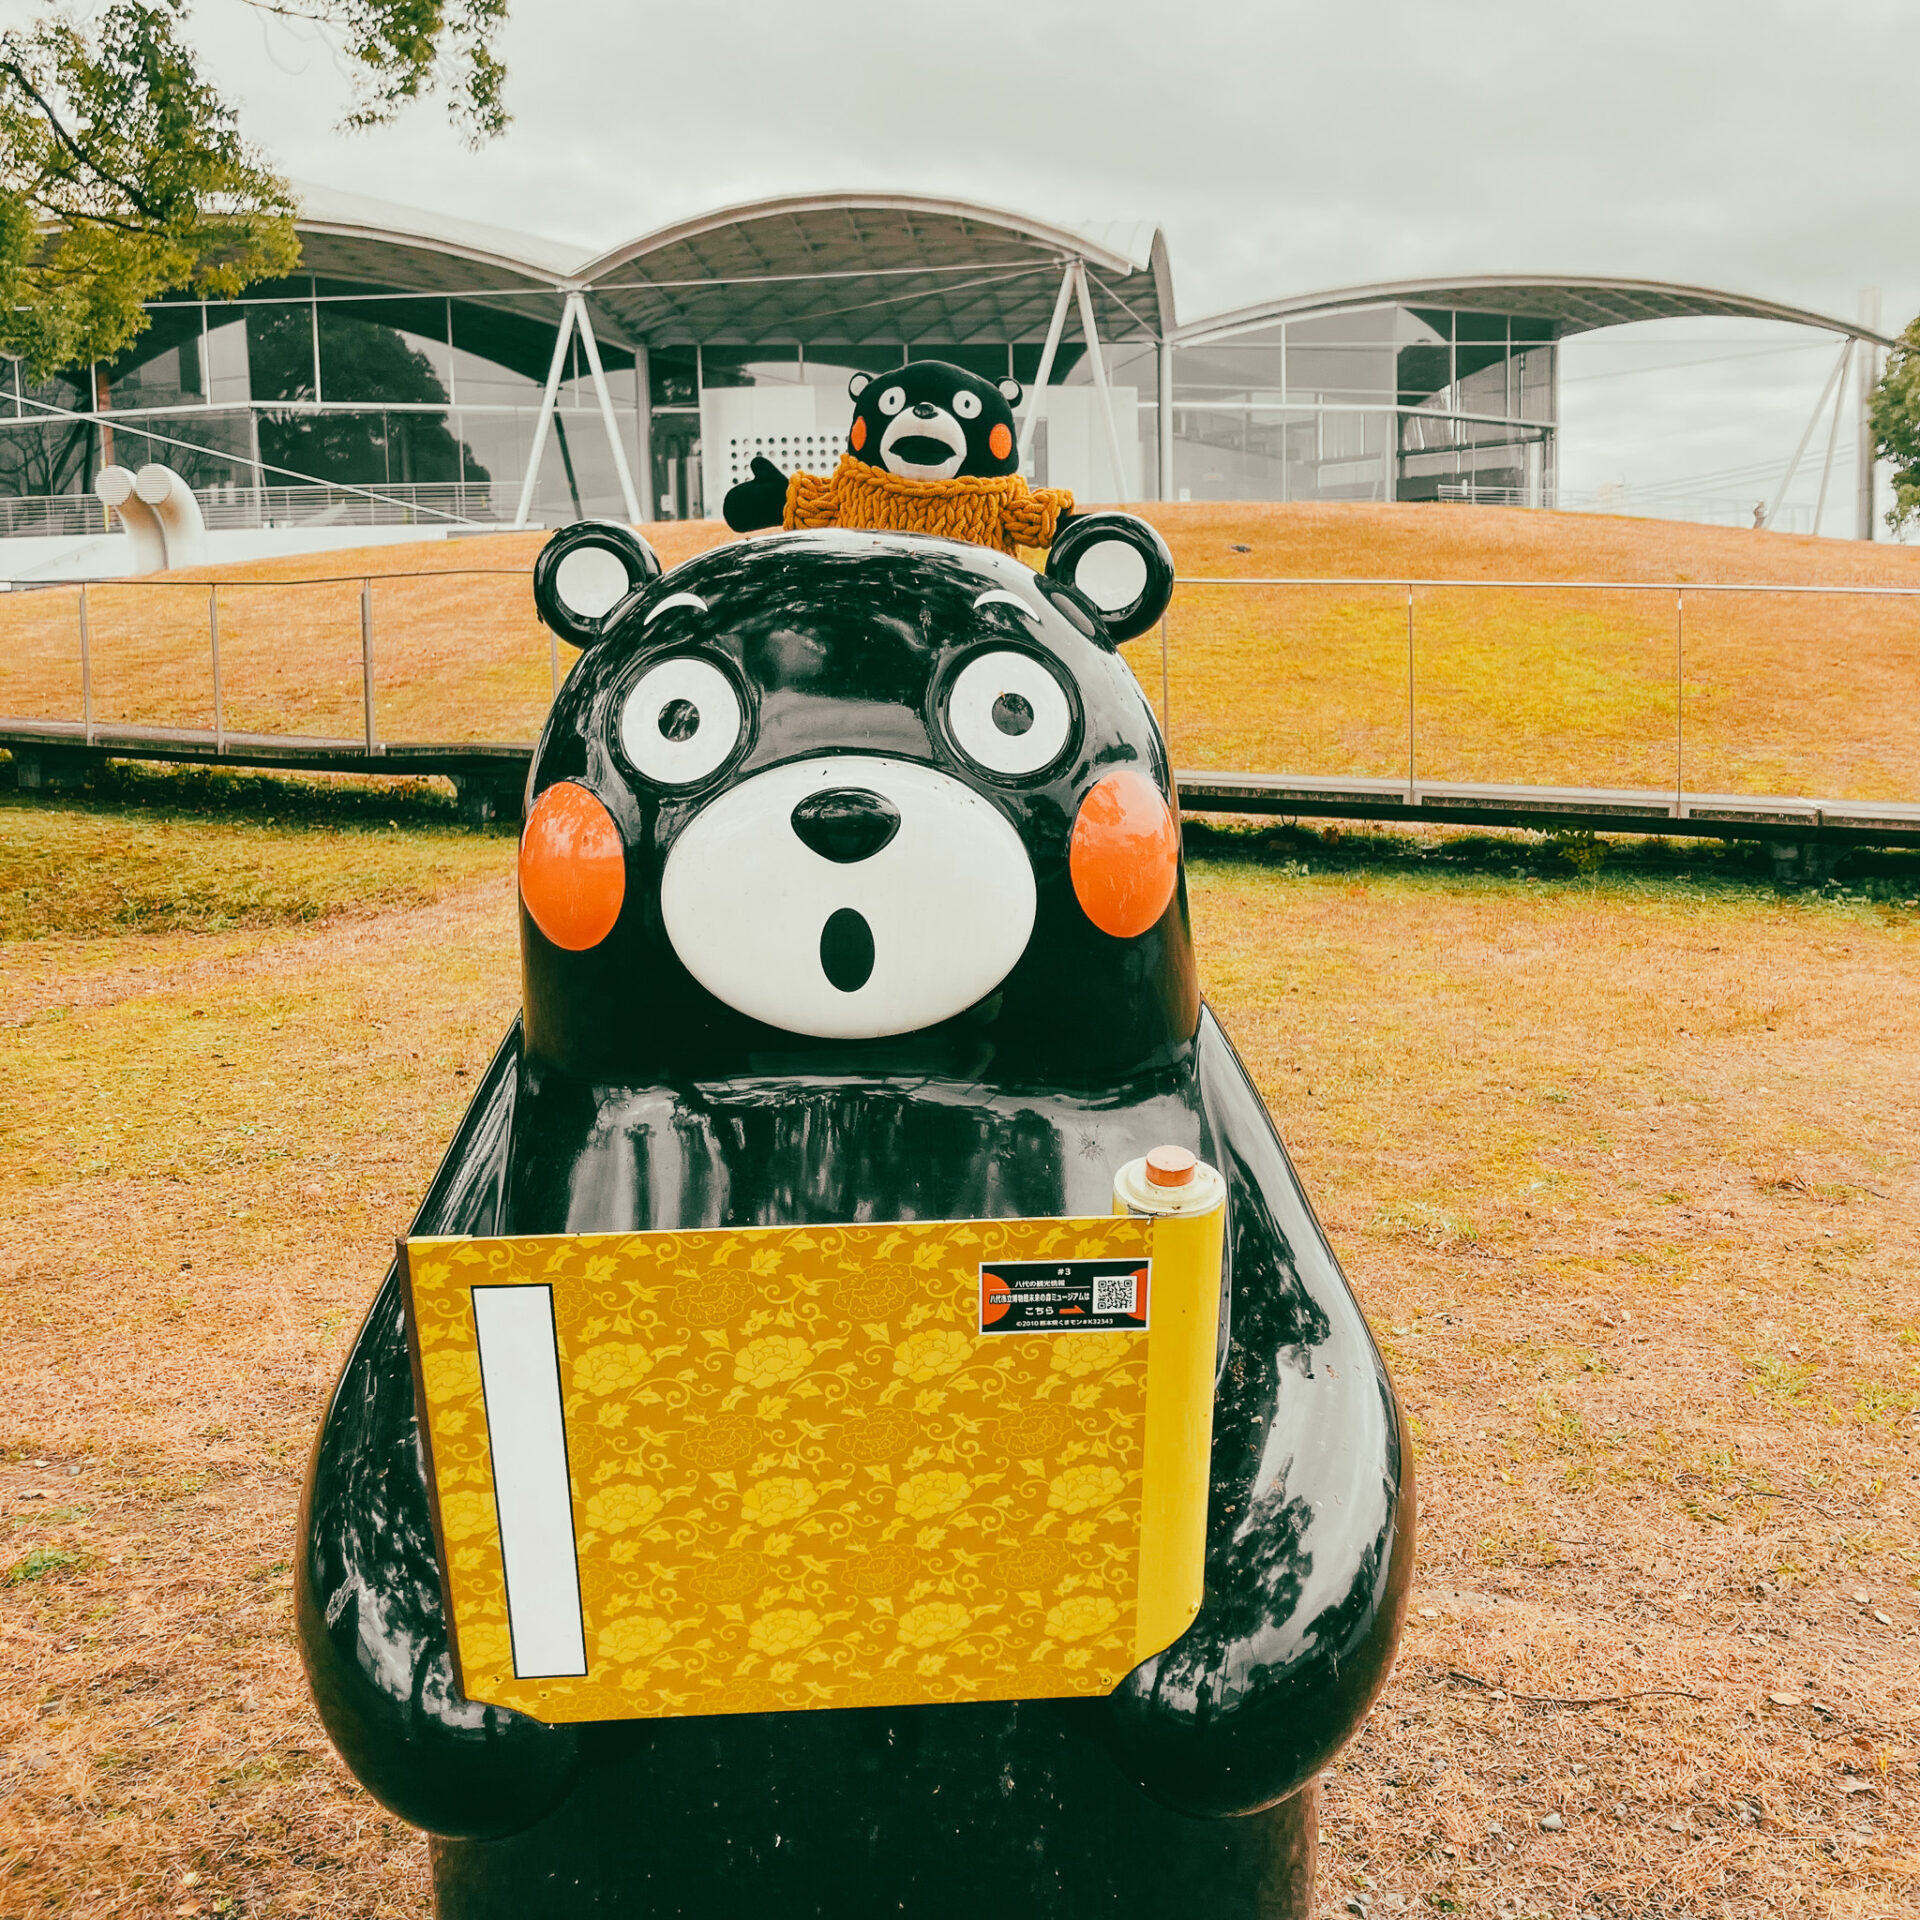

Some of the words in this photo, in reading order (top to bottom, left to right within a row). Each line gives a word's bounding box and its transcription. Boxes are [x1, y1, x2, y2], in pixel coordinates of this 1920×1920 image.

[1057, 1267, 1072, 1276] #3
[1015, 1280, 1066, 1288] 八代の観光情報
[1025, 1306, 1055, 1316] こちら
